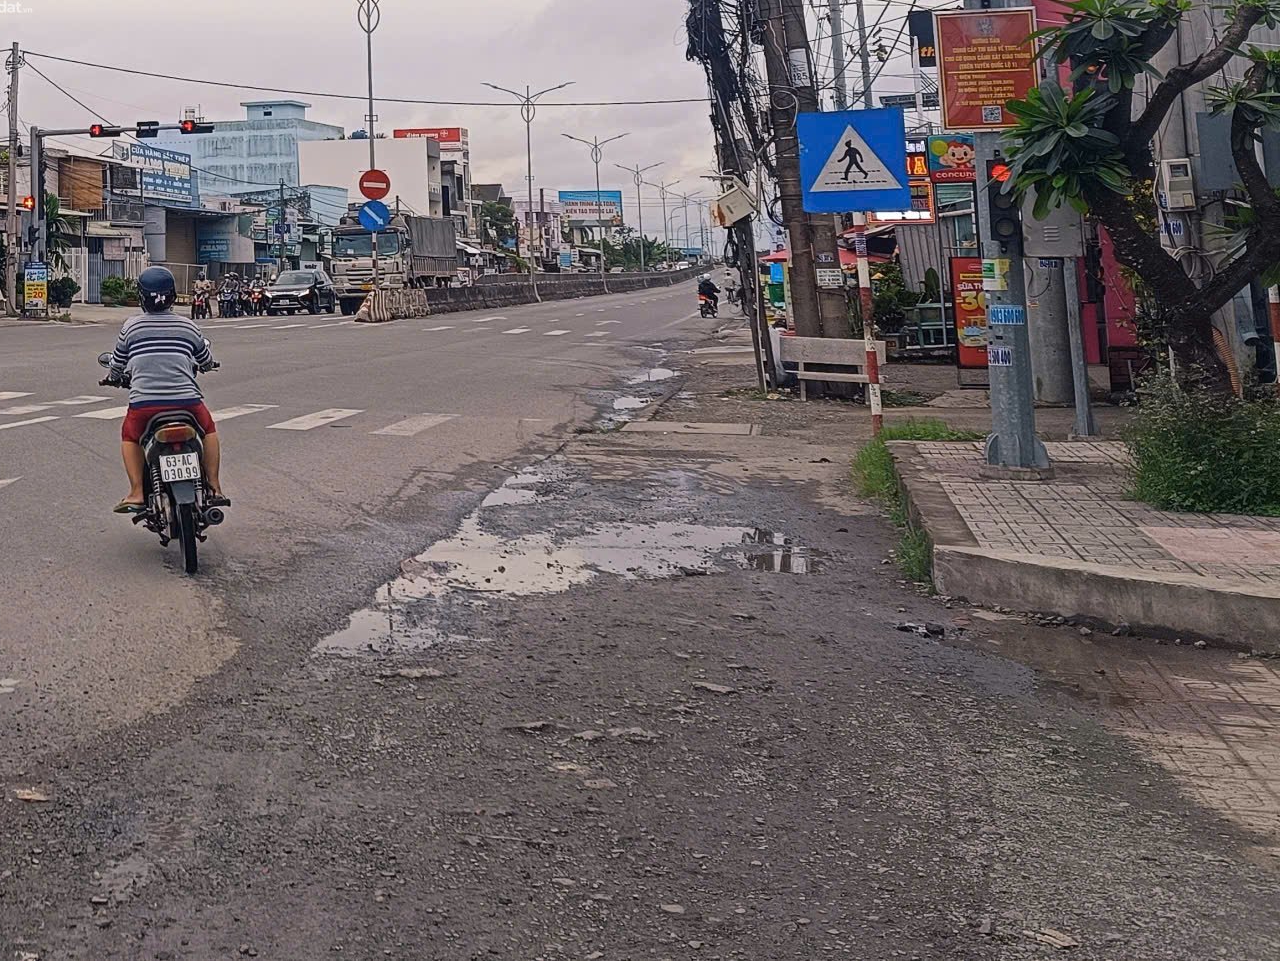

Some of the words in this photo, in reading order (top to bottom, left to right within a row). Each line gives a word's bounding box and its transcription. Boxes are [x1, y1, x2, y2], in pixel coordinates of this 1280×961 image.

[131, 146, 144, 155] CỬA
[145, 149, 162, 158] HÀNG
[165, 454, 193, 468] 63-AC
[164, 466, 199, 481] 030.99
